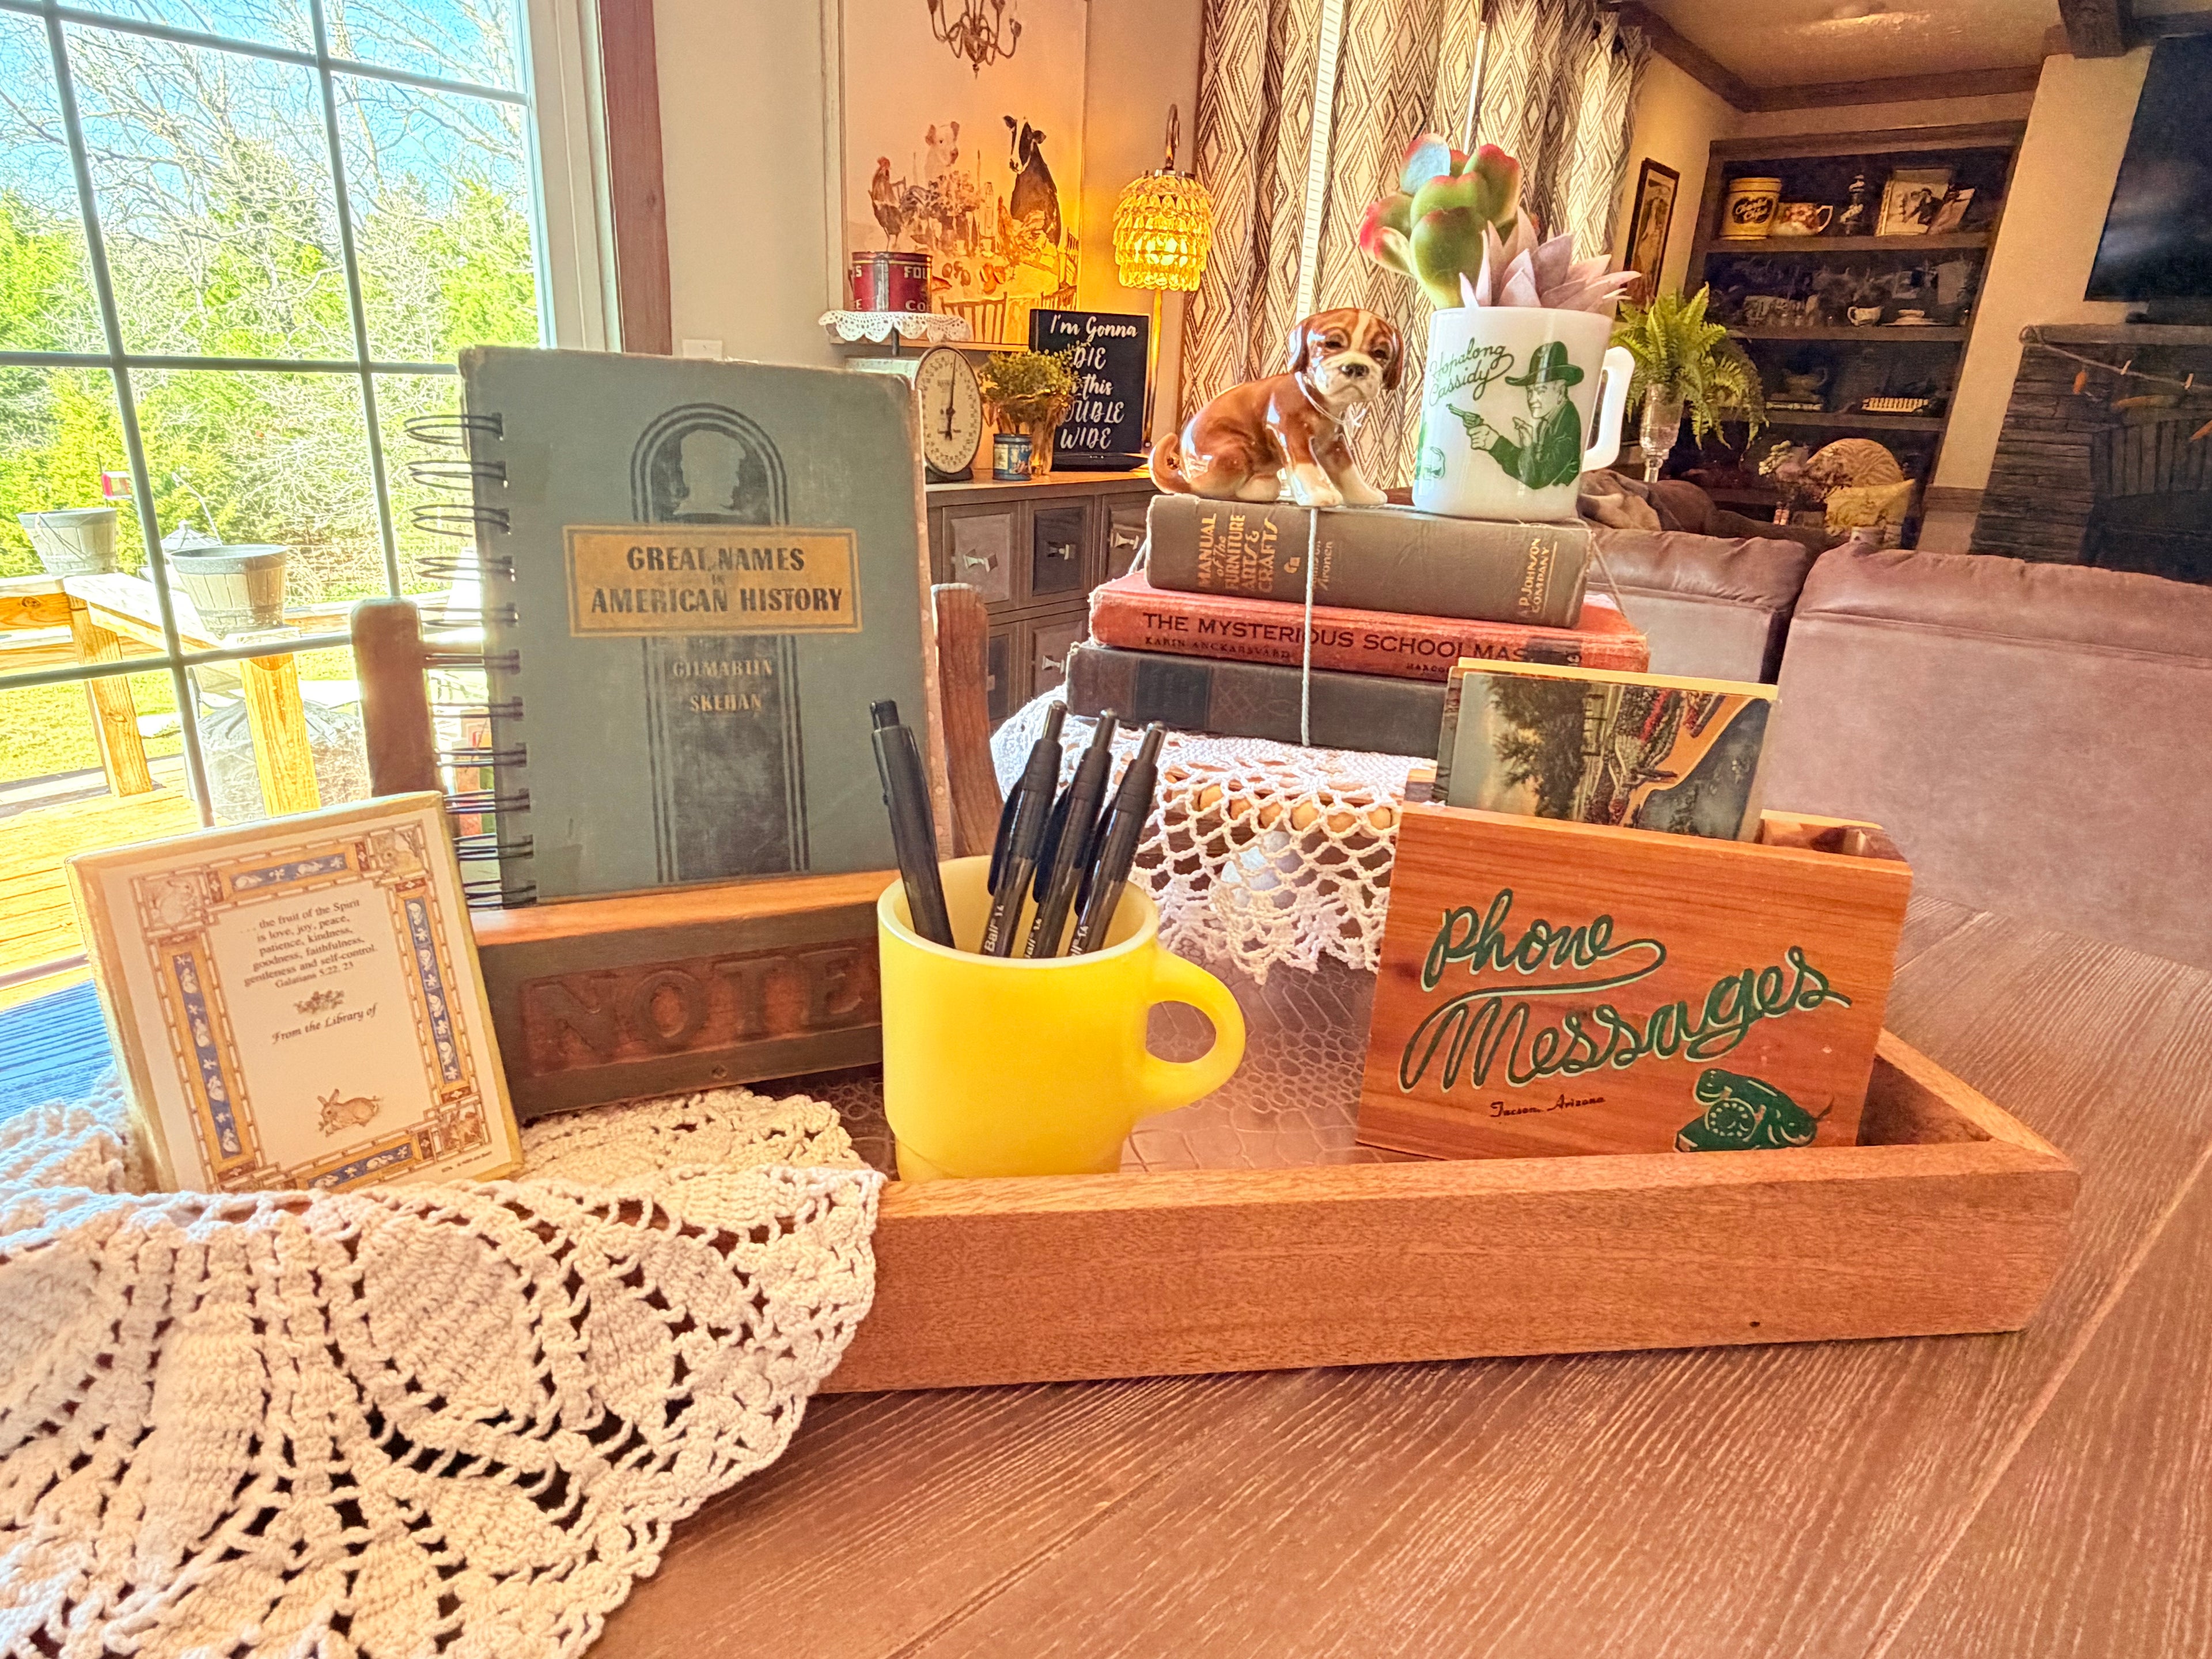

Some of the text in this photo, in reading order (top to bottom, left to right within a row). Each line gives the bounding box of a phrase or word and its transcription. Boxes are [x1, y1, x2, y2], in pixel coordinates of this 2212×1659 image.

[1050, 314, 1138, 342] I'm Gonna
[1073, 347, 1107, 370] DIE
[1430, 337, 1506, 381] Hopalong
[1082, 373, 1113, 400] this
[1429, 359, 1514, 407] Cassidy
[1065, 400, 1124, 423] UBLE
[1060, 426, 1112, 449] WIDE
[626, 546, 805, 572] GREAT NAMES
[1197, 513, 1217, 588] MANUAL
[1225, 514, 1246, 590] FURNITURE
[1241, 530, 1260, 592] ARTS &
[1258, 517, 1278, 593] CRAFTS
[1521, 538, 1541, 599] JOHNSON
[1532, 546, 1550, 613] COMPANY
[591, 587, 843, 613] AMERICAN HISTORY
[1143, 612, 1189, 632] THE
[1198, 618, 1354, 648] MYSTERIOUS
[1145, 636, 1185, 647] KARIN
[672, 658, 773, 677] GILMARTIN
[690, 693, 762, 714] SKEHAN
[257, 915, 350, 942] is love, joy, peace,
[259, 899, 360, 929] the fruit of the Spirit
[259, 927, 353, 957] patience, kindness,
[984, 923, 999, 952] Ball
[252, 937, 365, 972] goodness, faithfulness,
[244, 967, 297, 987] gentleness
[300, 959, 317, 971] and
[275, 973, 317, 988] Galatians
[271, 1002, 378, 1045] From the Library of
[1398, 945, 1852, 1093] Messages
[1547, 1093, 1606, 1111] Arizona
